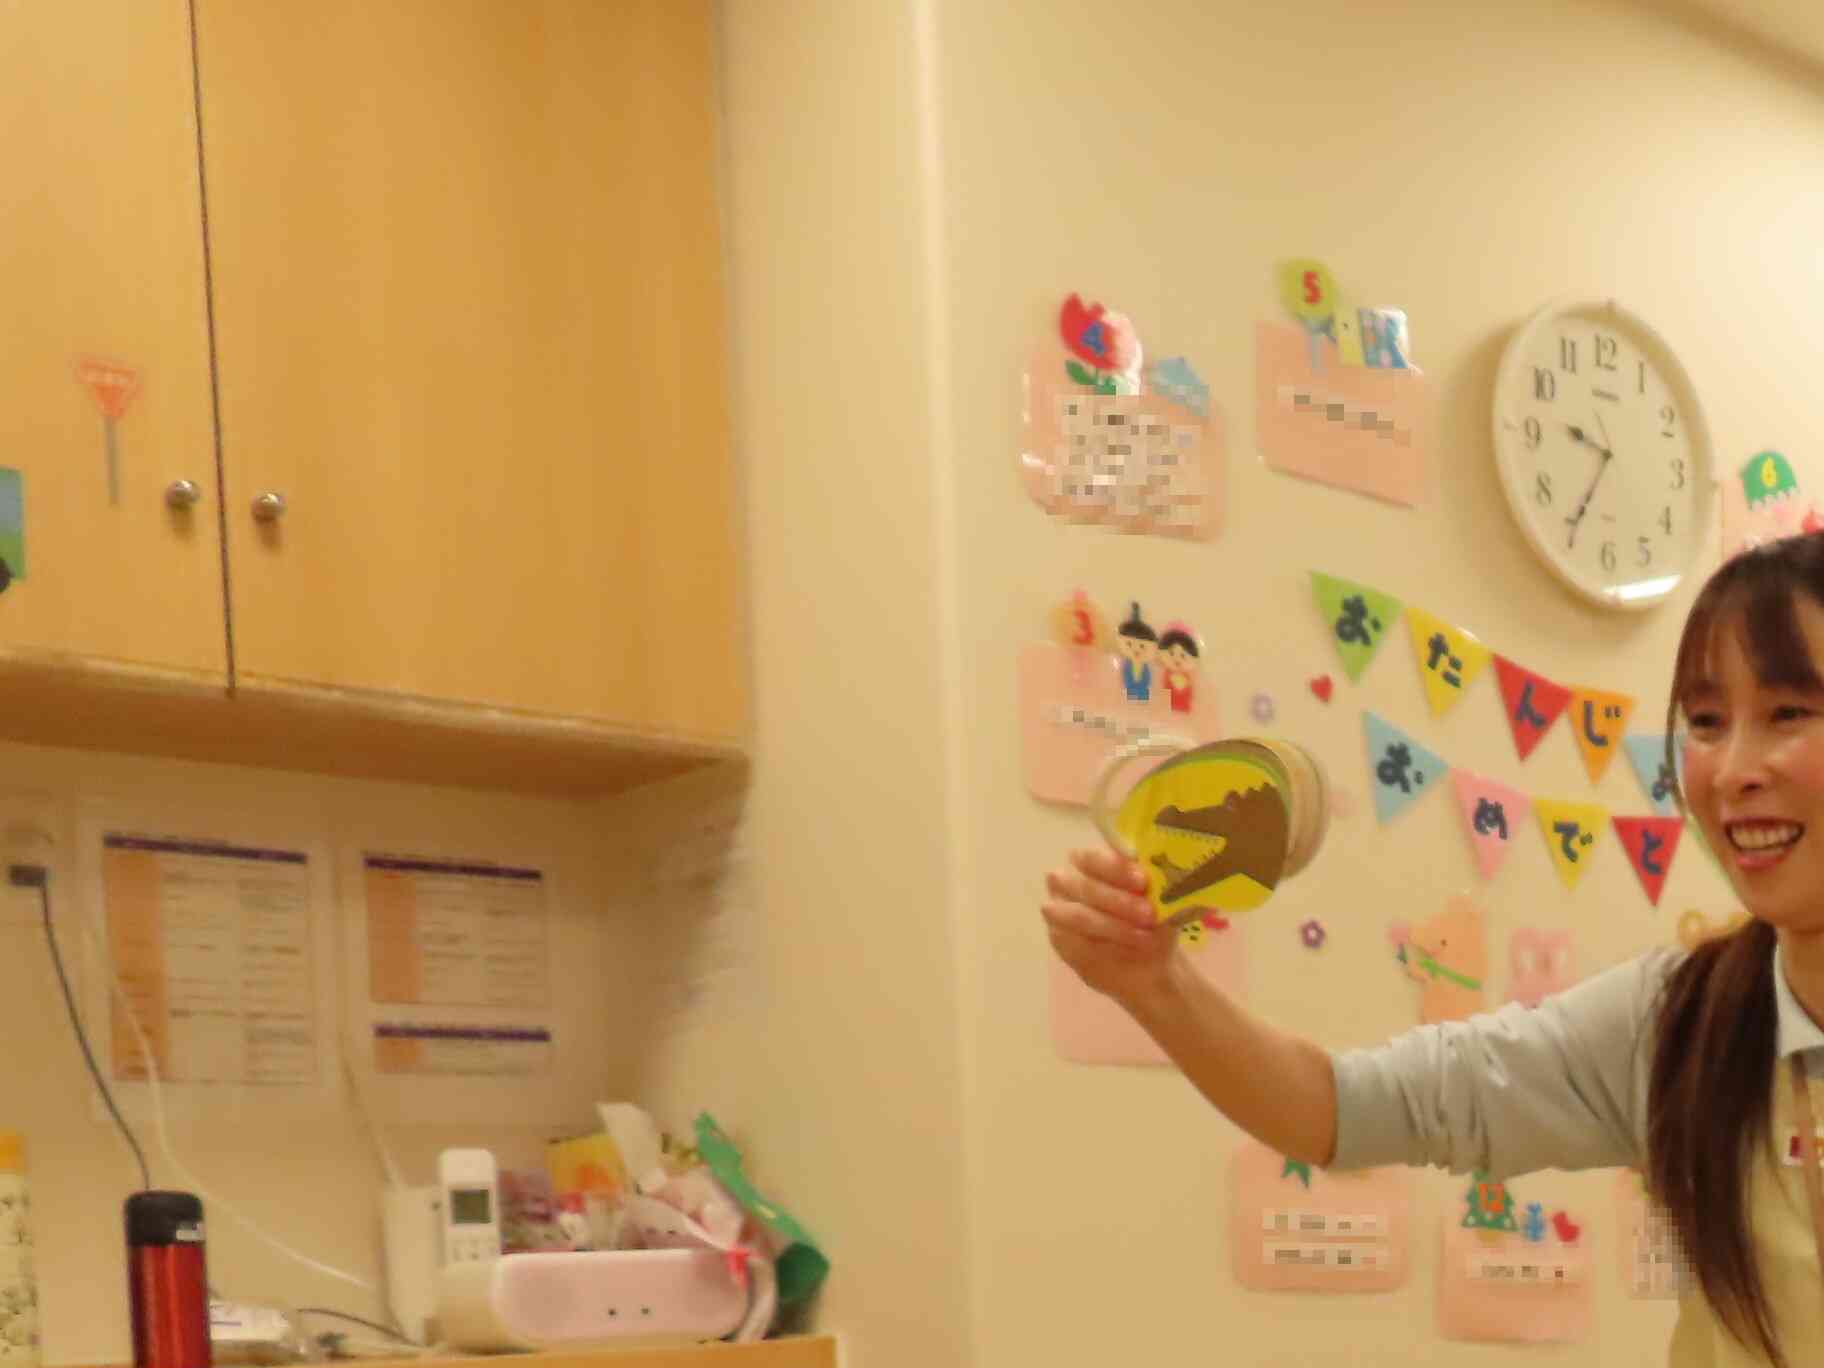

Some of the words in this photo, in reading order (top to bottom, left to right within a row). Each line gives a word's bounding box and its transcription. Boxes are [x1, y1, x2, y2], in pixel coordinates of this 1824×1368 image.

[1303, 271, 1321, 304] 5
[1081, 321, 1105, 354] 4
[1594, 333, 1617, 371] 12
[1559, 336, 1578, 375] 11
[1533, 367, 1555, 401] 10
[1637, 361, 1645, 395] 1
[1524, 416, 1541, 449] 9
[1660, 405, 1675, 439] 2
[1670, 459, 1685, 490] 3
[1761, 457, 1776, 487] 6
[1536, 473, 1552, 505] 8
[1660, 506, 1672, 535] 4
[1600, 541, 1616, 572] 6
[1637, 536, 1650, 567] 5
[1073, 609, 1094, 645] 3
